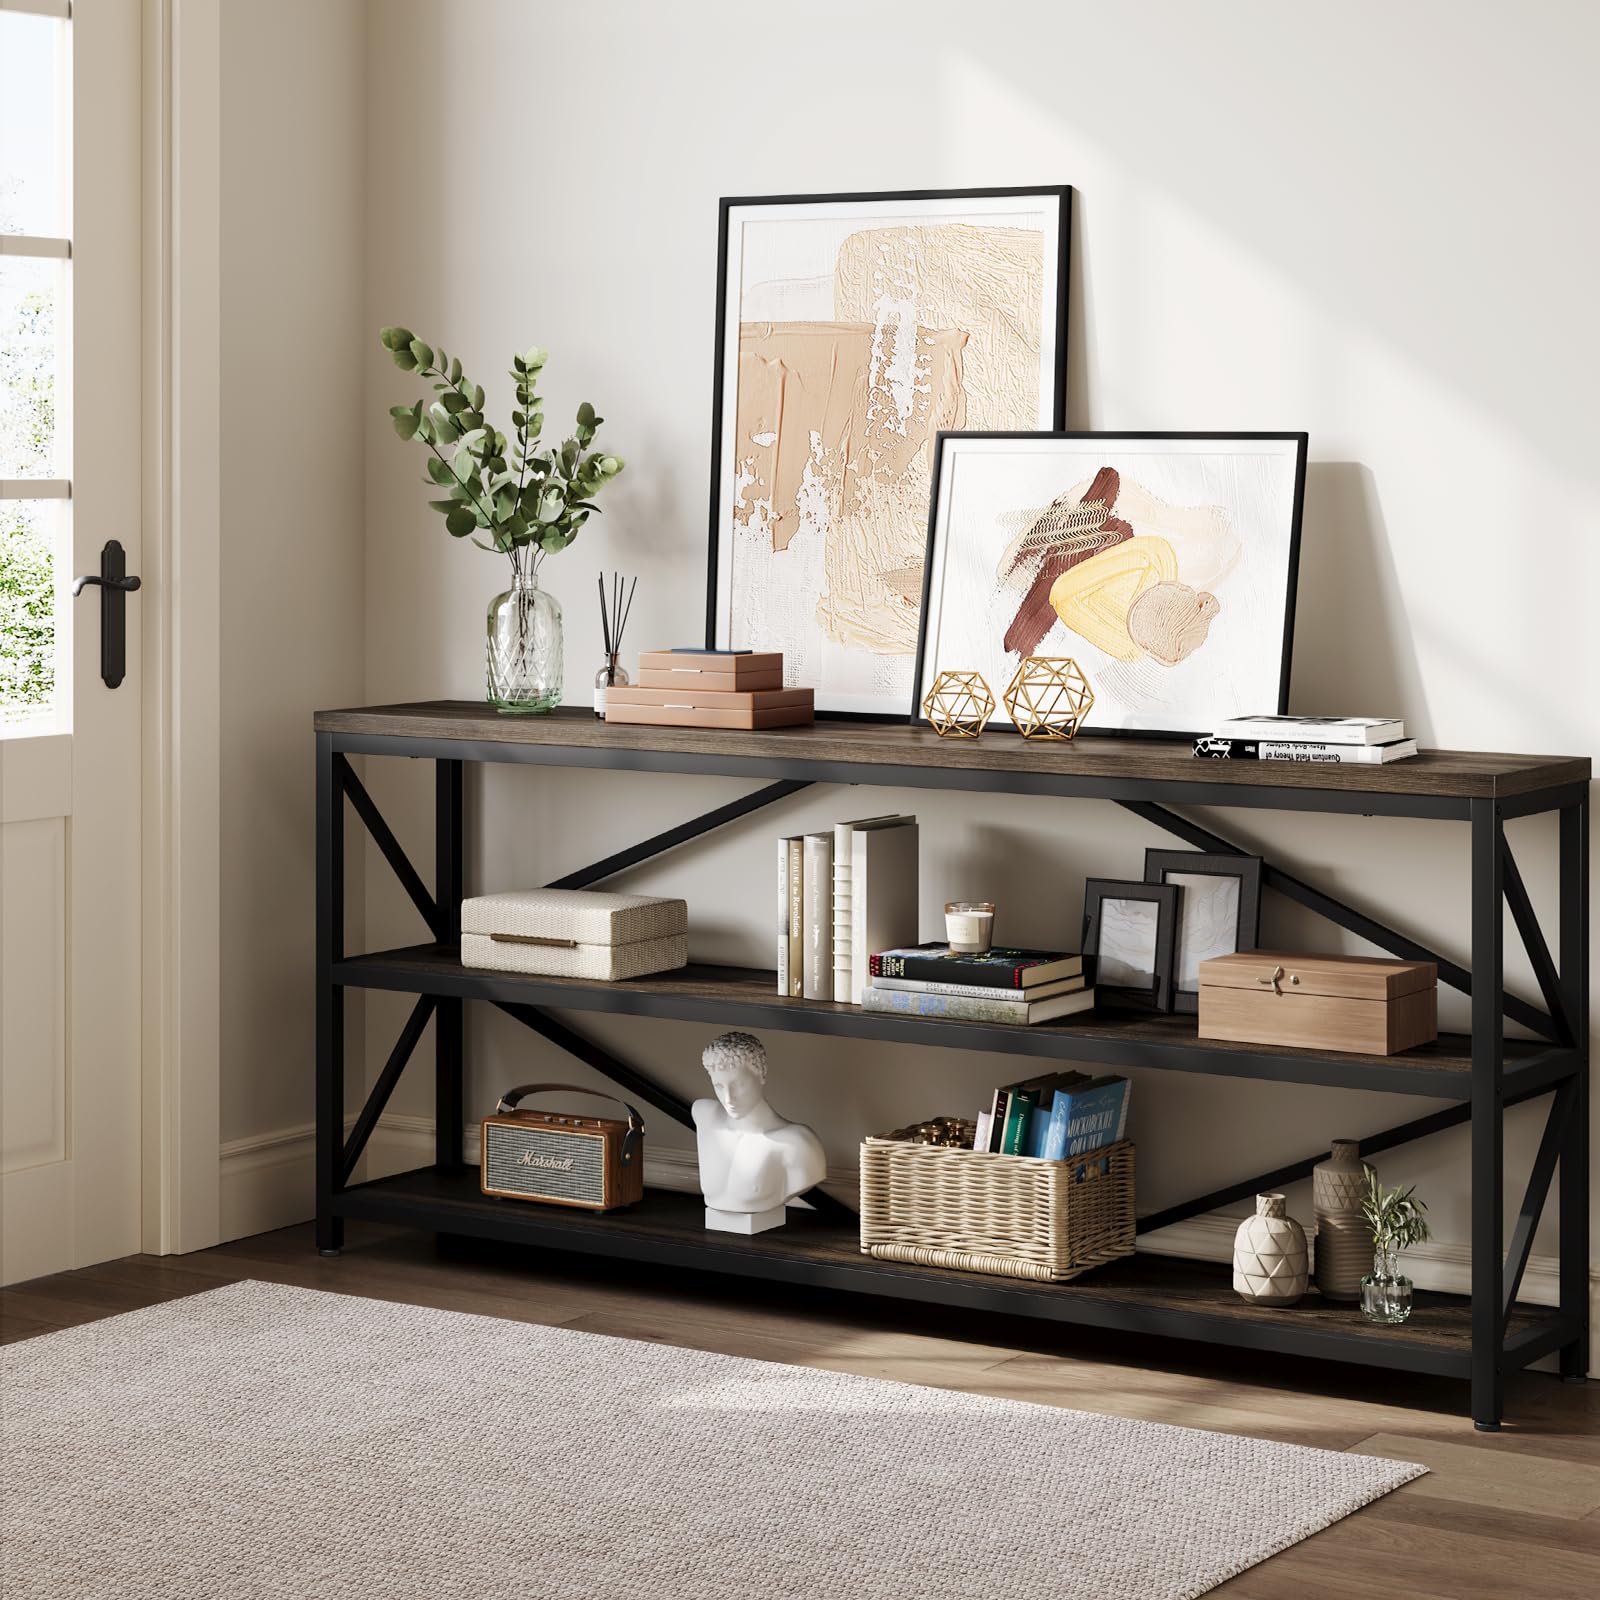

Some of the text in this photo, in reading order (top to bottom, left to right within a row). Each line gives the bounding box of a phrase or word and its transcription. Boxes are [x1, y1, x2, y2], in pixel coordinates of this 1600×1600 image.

[1265, 750, 1341, 763] Quantum Field Theory of
[792, 896, 801, 938] Revolution
[1068, 1109, 1114, 1137] МОСКОВСКИЕ
[1070, 1132, 1103, 1156] ФИАЛКИ
[517, 1150, 576, 1170] Marshall
